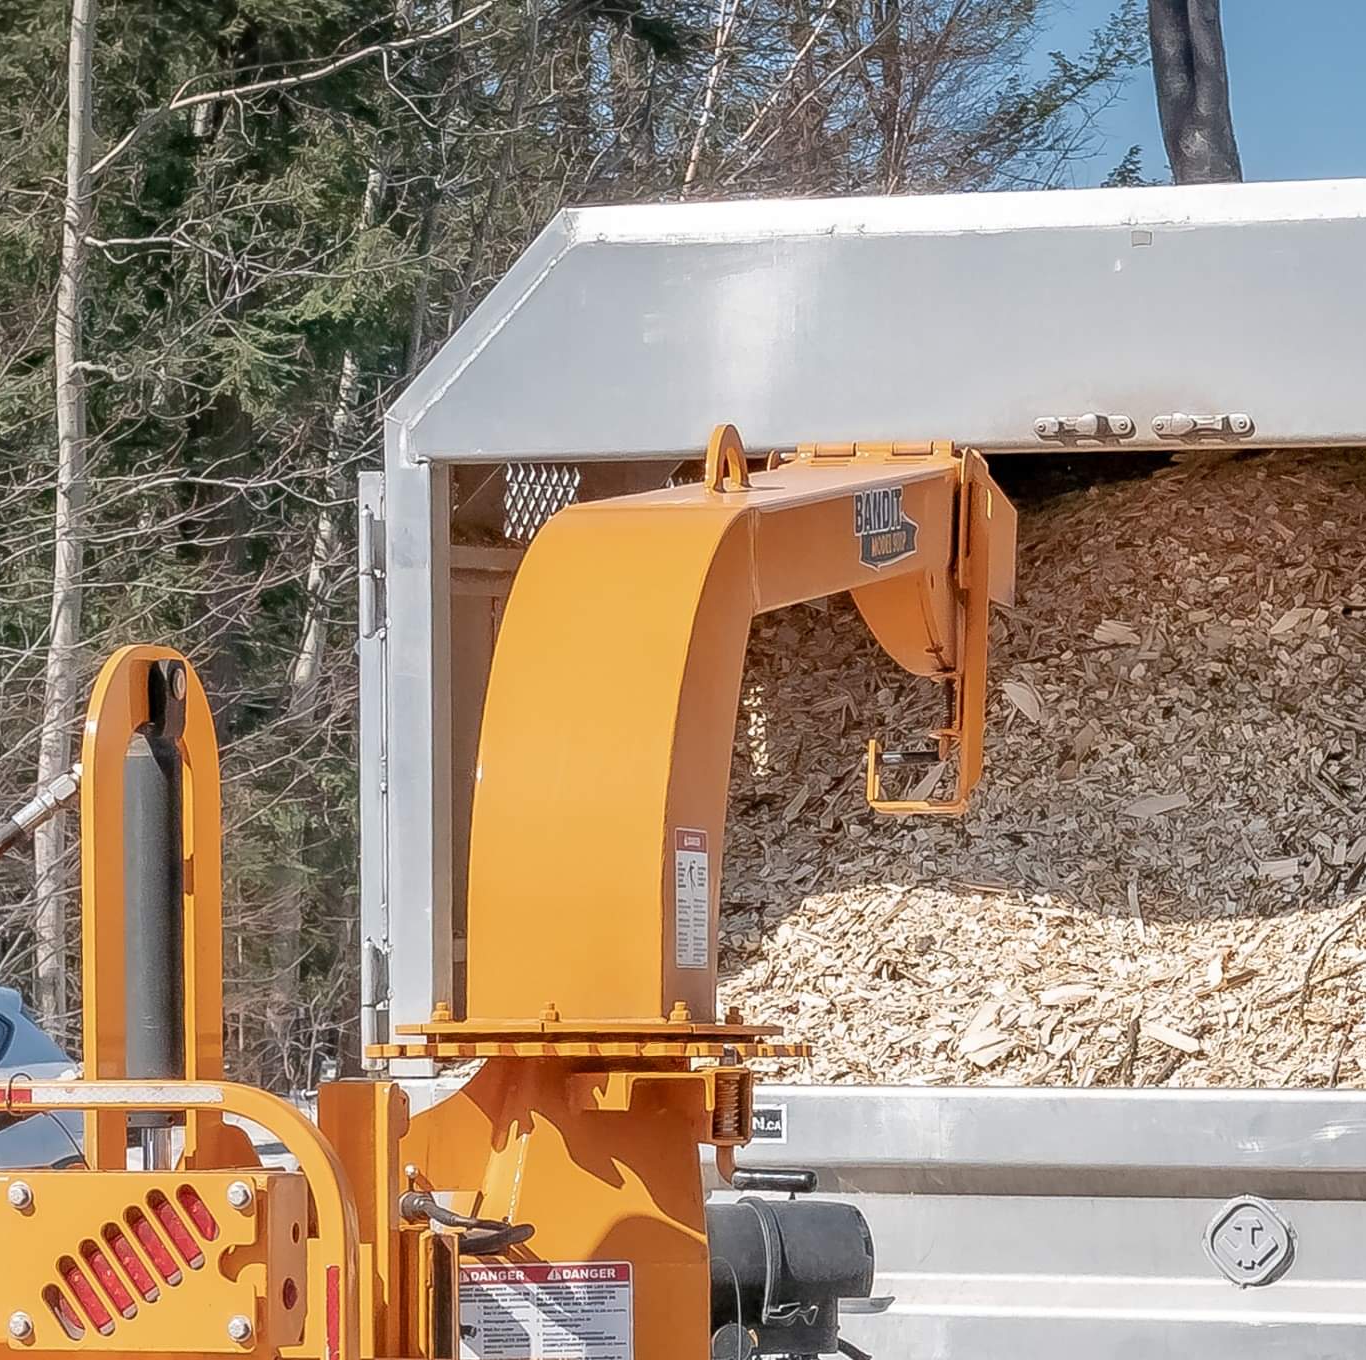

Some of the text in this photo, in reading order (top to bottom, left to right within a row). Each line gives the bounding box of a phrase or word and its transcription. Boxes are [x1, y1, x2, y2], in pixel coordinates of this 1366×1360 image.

[854, 487, 903, 534] BANDIT
[470, 1270, 525, 1282] DANGER
[562, 1268, 616, 1280] DANGER
